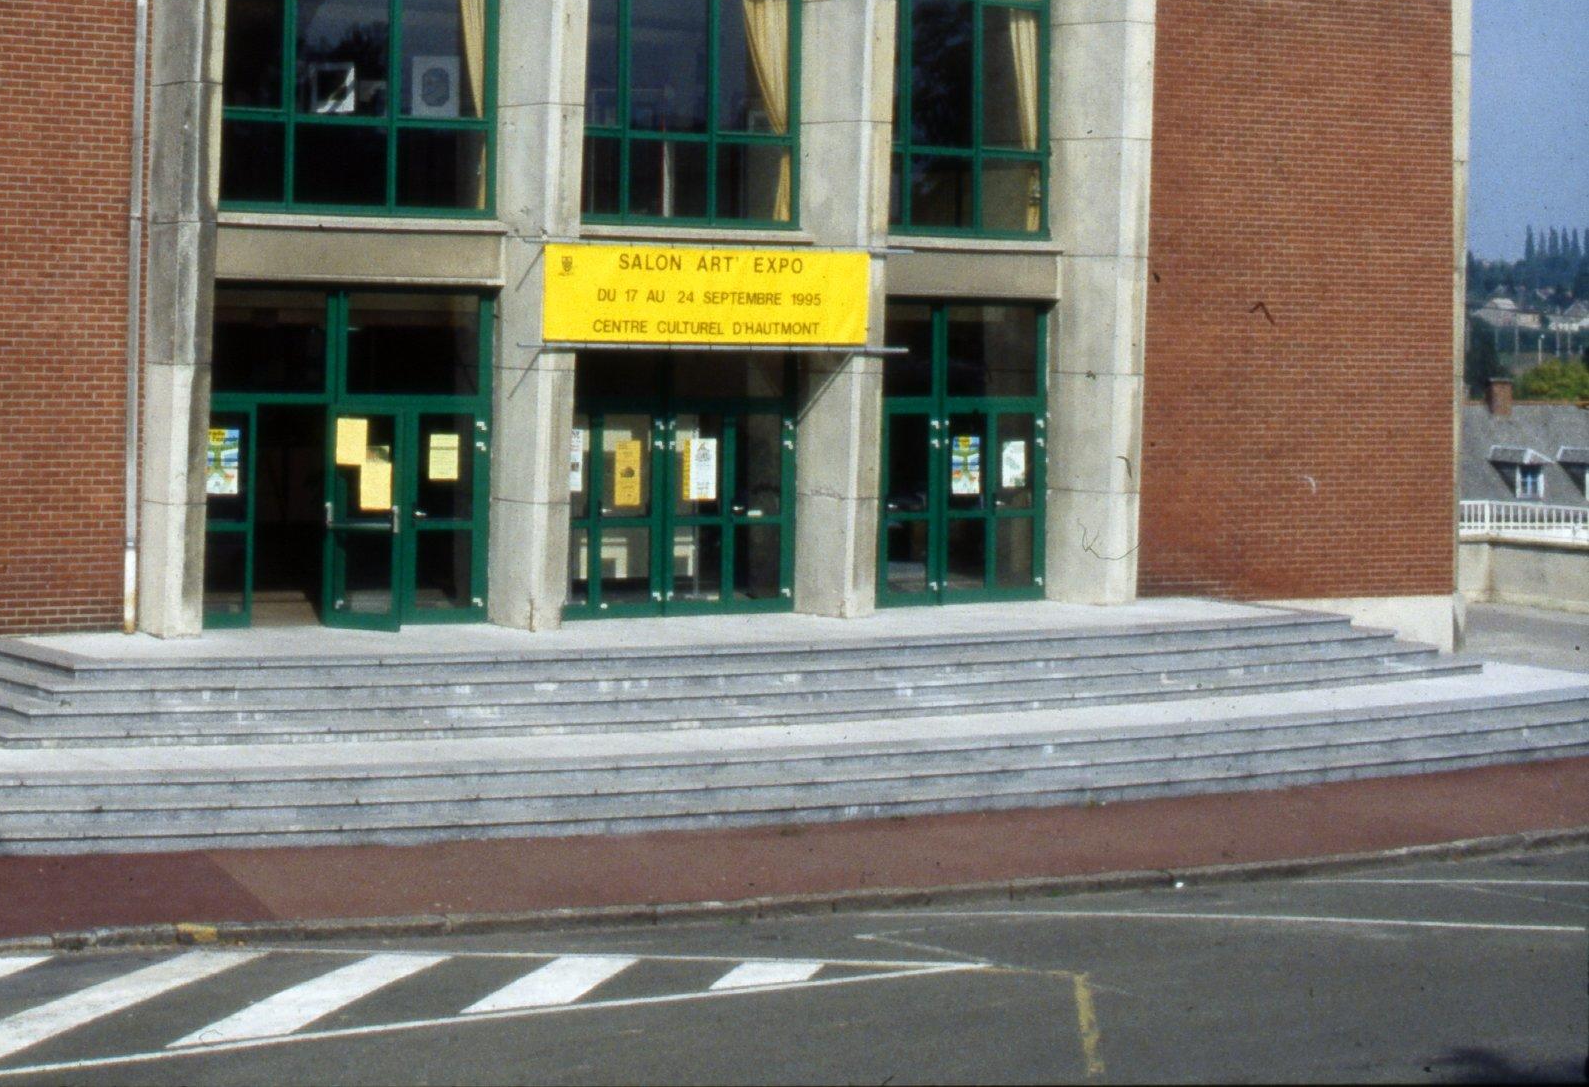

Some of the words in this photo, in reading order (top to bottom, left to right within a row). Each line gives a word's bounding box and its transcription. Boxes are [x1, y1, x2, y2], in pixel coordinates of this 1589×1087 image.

[618, 253, 682, 272] SALON
[754, 256, 804, 275] EXPO
[597, 288, 617, 303] DU
[625, 289, 638, 303] 17
[646, 290, 666, 304] AU
[677, 290, 694, 304] 24
[703, 291, 782, 306] SEPTEMBRE
[792, 293, 822, 307] 1995
[592, 318, 648, 334] CENTRE
[657, 320, 724, 336] CULTUREL
[733, 321, 821, 336] D'HAUTMONT
